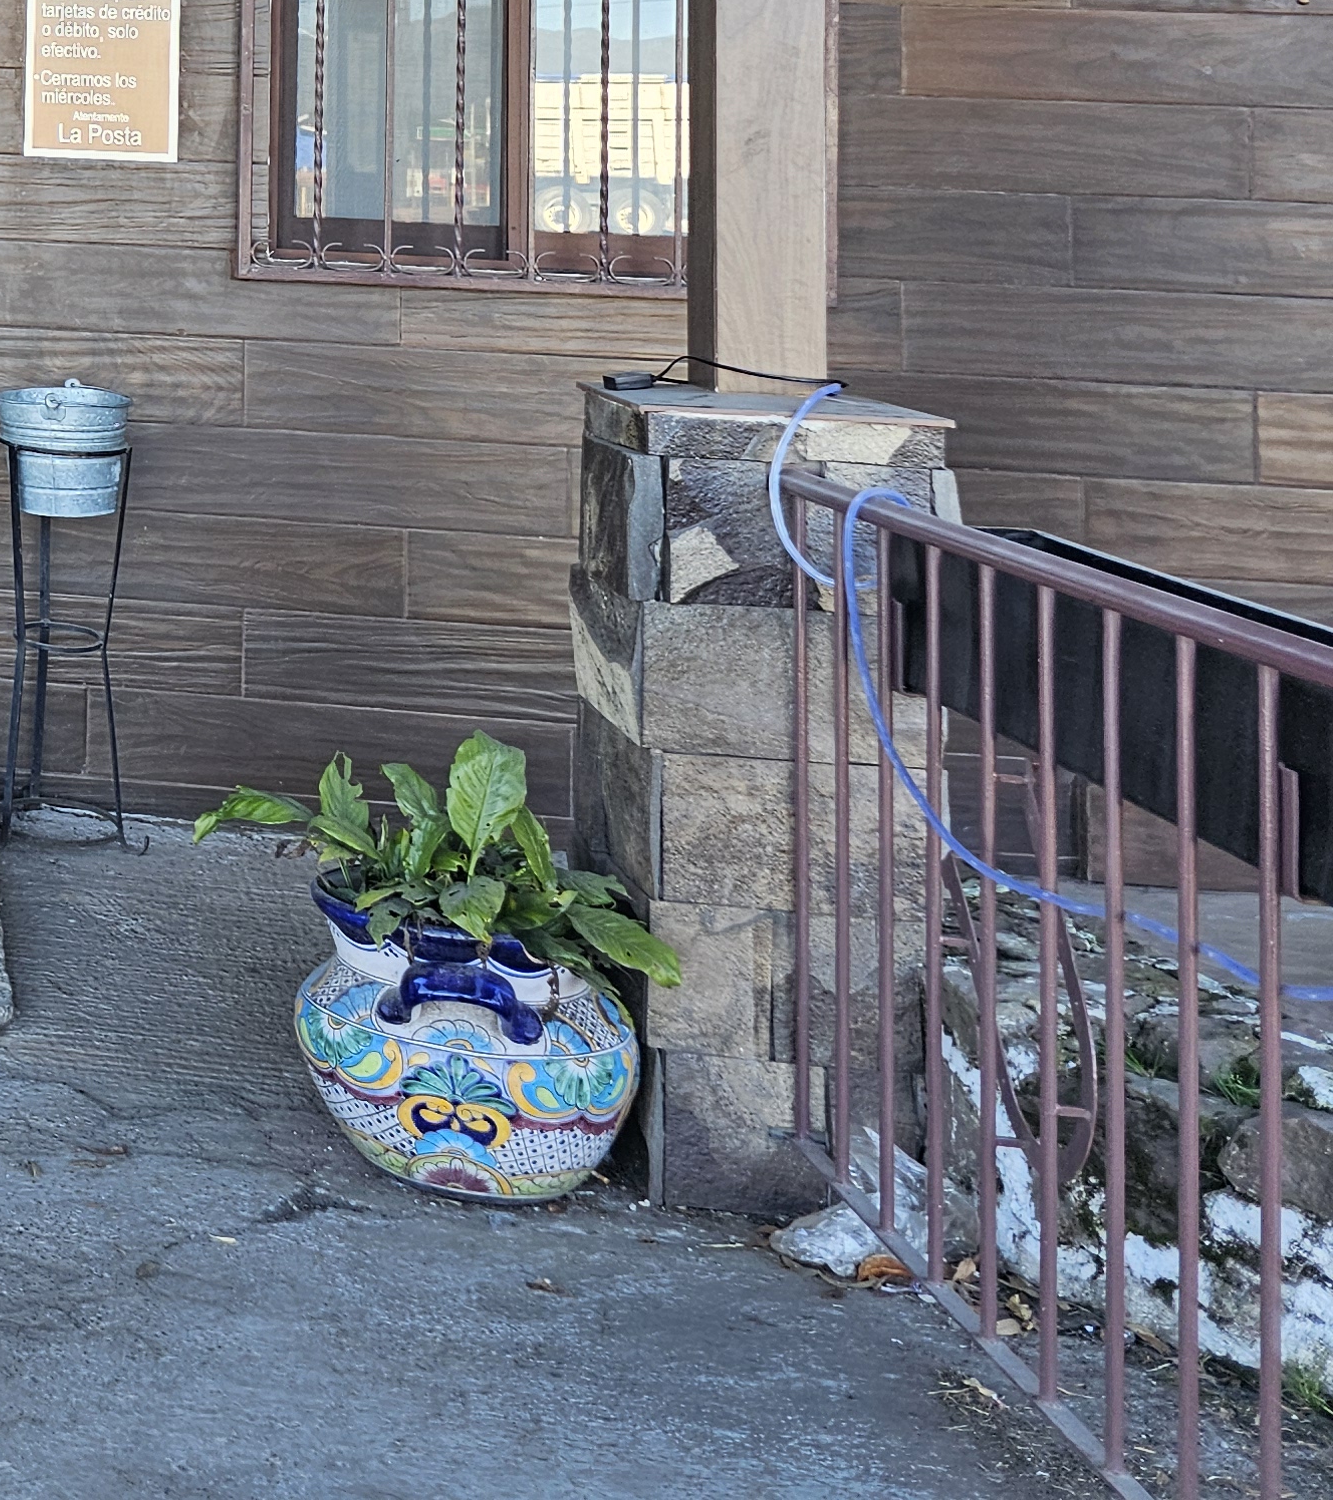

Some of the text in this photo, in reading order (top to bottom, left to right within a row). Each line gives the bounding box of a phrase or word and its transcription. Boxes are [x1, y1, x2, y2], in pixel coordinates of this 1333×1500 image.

[99, 4, 116, 19] de
[42, 25, 51, 37] o
[107, 24, 138, 39] solo
[41, 70, 137, 88] Cerramos los
[58, 123, 142, 146] La Posta
